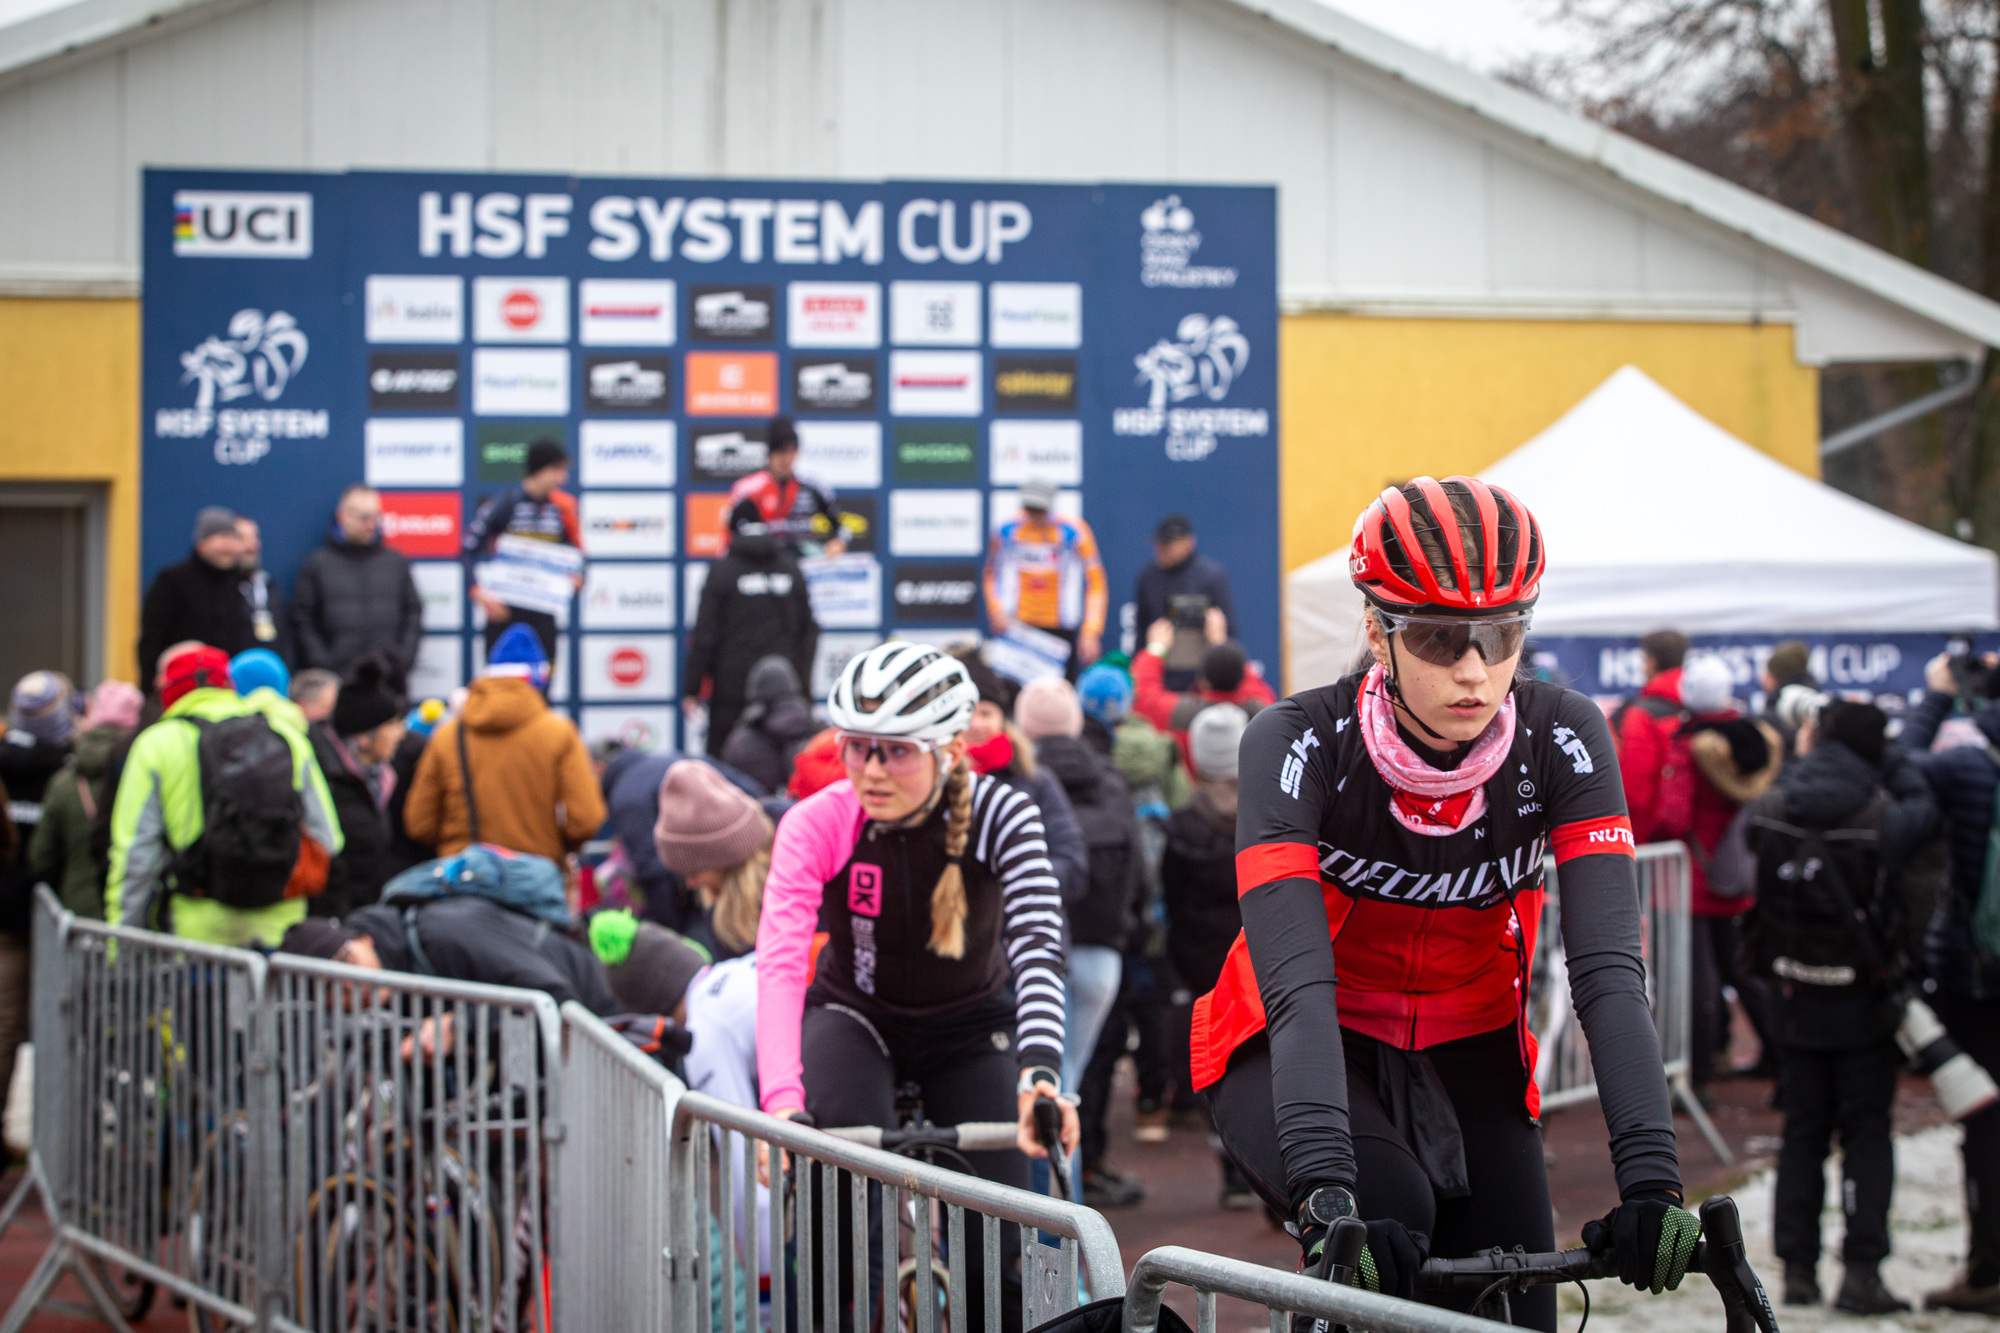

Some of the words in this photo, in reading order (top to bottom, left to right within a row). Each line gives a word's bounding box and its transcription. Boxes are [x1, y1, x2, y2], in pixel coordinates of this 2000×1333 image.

[201, 206, 297, 243] UCI
[419, 191, 573, 259] HSF
[588, 195, 884, 265] SYSTEM
[897, 198, 1033, 264] CUP
[155, 408, 214, 438] HSF
[217, 408, 329, 438] SYSTEM
[1113, 407, 1166, 436] HSF
[1168, 407, 1269, 436] SYSTEM
[214, 437, 271, 465] CUP
[1165, 434, 1217, 461] CUP
[1599, 648, 1646, 688] HS
[1830, 643, 1902, 684] CUP
